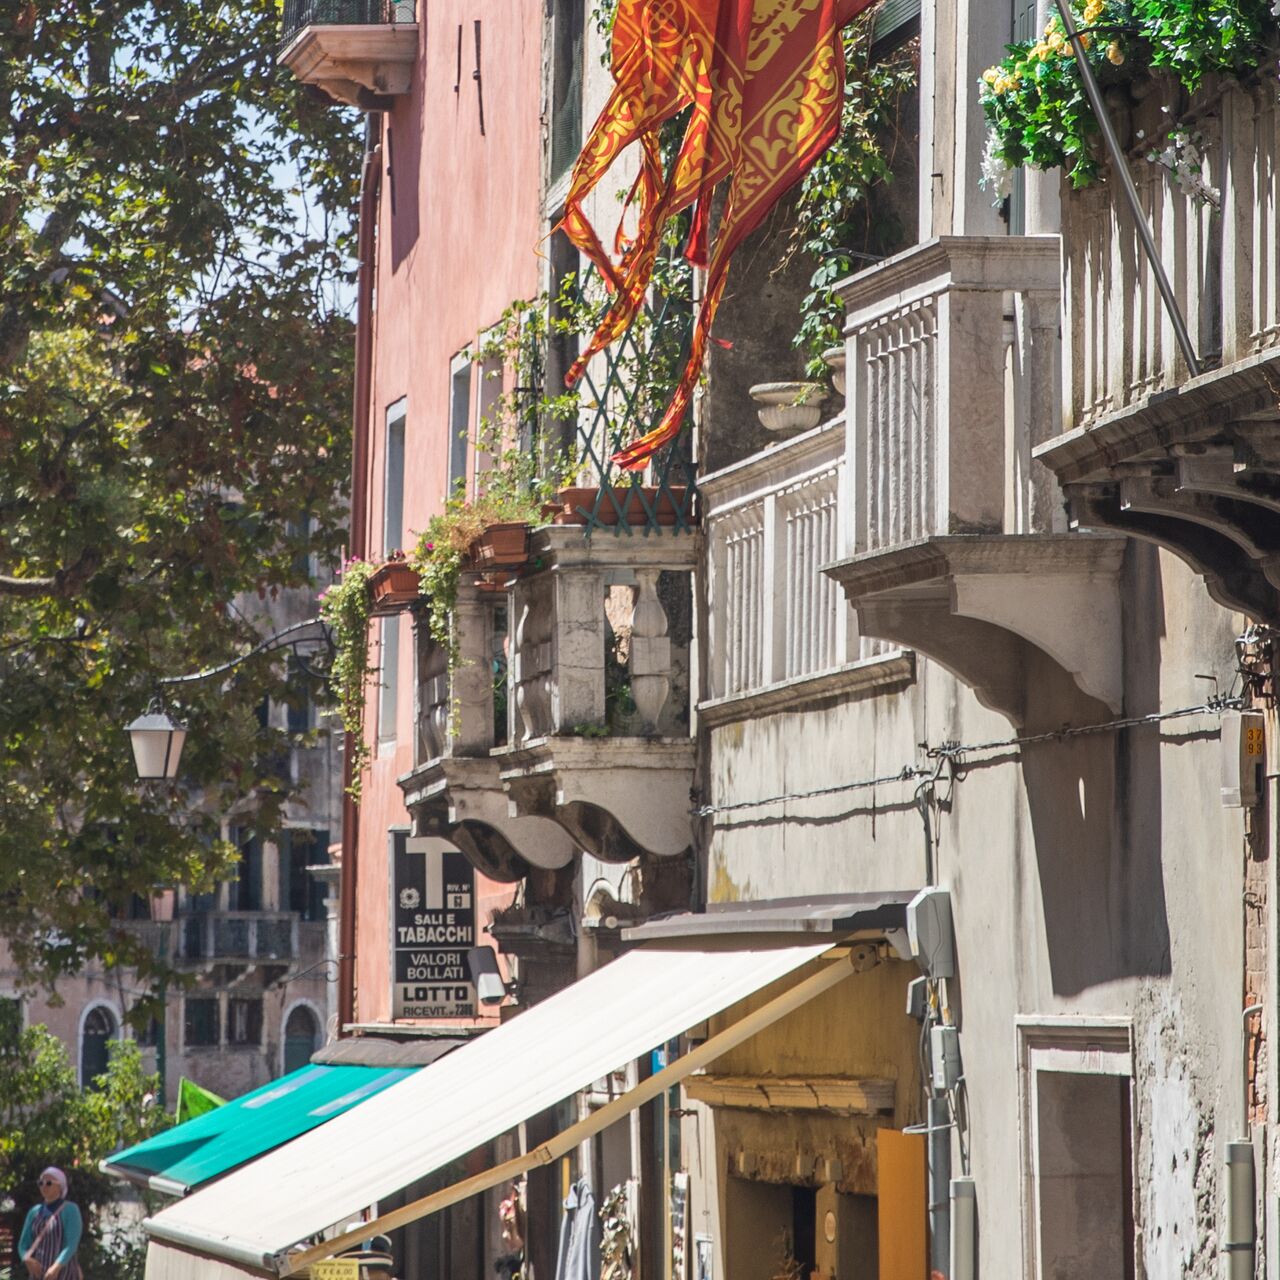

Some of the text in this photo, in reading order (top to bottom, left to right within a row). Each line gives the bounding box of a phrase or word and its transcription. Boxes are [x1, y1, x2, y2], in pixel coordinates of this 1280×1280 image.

[1248, 729, 1262, 741] 37
[1248, 744, 1262, 754] 93
[406, 836, 462, 909] T
[414, 914, 456, 925] SALI E
[397, 926, 472, 943] TABACCHI
[410, 953, 461, 966] VALORI
[407, 967, 464, 980] BOLLATI
[403, 986, 469, 1002] LOTTO
[403, 1006, 448, 1017] RICEVIT.
